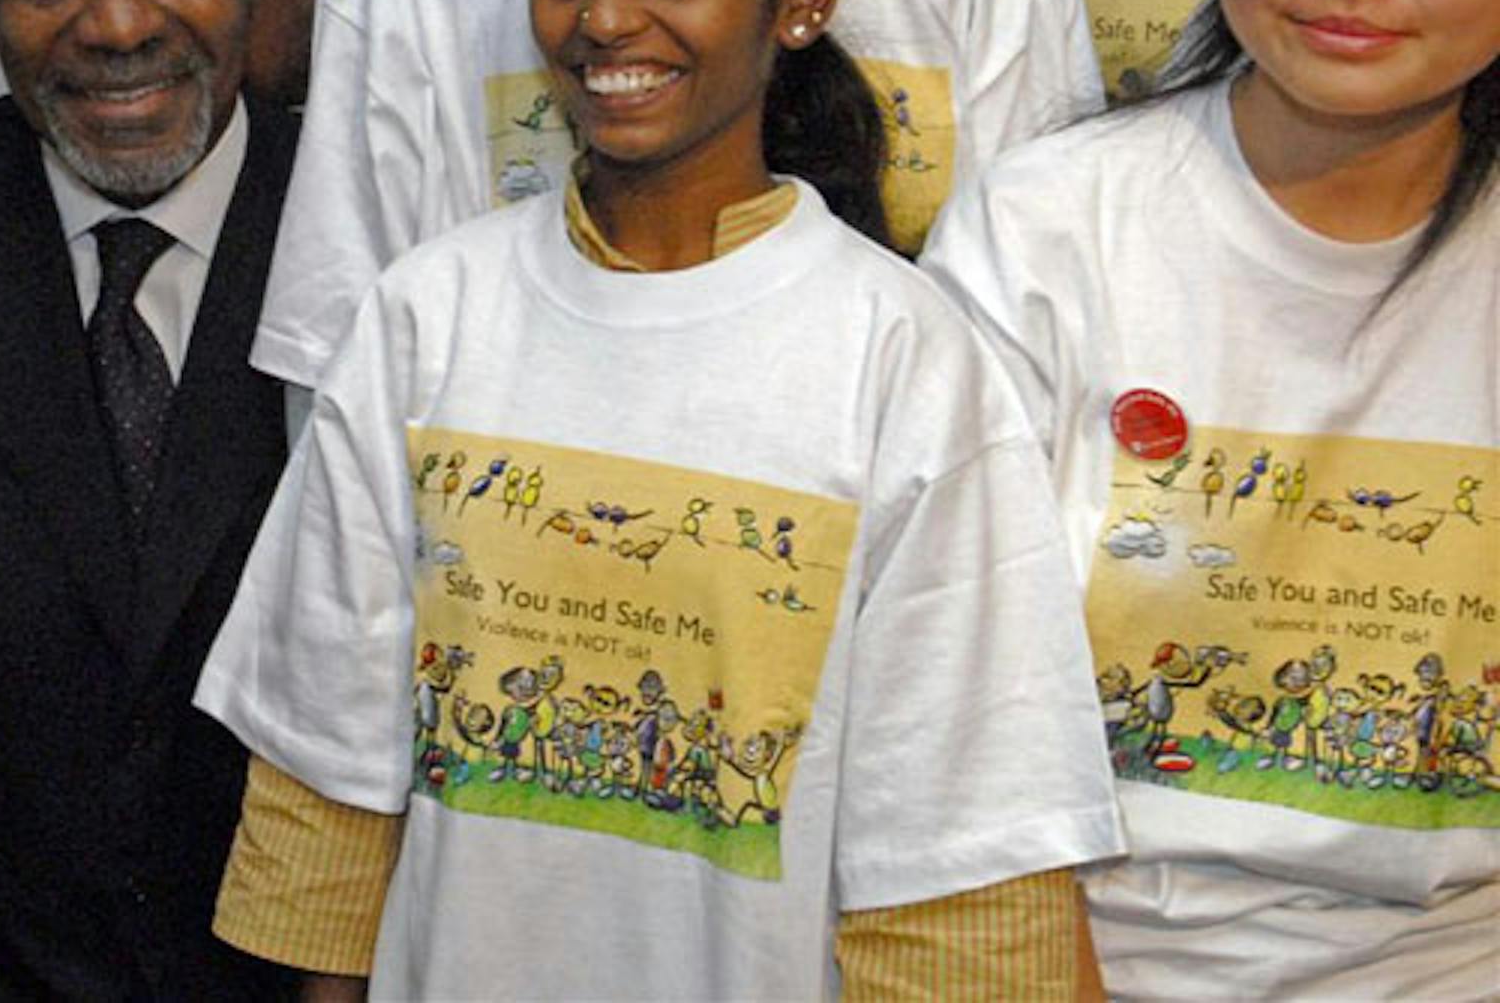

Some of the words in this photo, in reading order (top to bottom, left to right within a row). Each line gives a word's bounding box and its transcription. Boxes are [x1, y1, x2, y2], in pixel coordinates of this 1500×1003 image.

[1094, 16, 1135, 41] Safe
[444, 570, 485, 601] Safe
[497, 579, 549, 613] You
[559, 597, 607, 623] and
[615, 600, 667, 635] Safe
[676, 614, 716, 646] Me
[1206, 573, 1258, 602] Safe
[1266, 576, 1316, 604] You
[1325, 584, 1378, 610] and
[1388, 586, 1447, 617] Safe
[1457, 594, 1497, 624] Me
[476, 615, 549, 644] Violence
[554, 632, 568, 646] is
[575, 632, 620, 655] NOT
[1252, 616, 1318, 634] Violence
[1346, 621, 1396, 641] NOT
